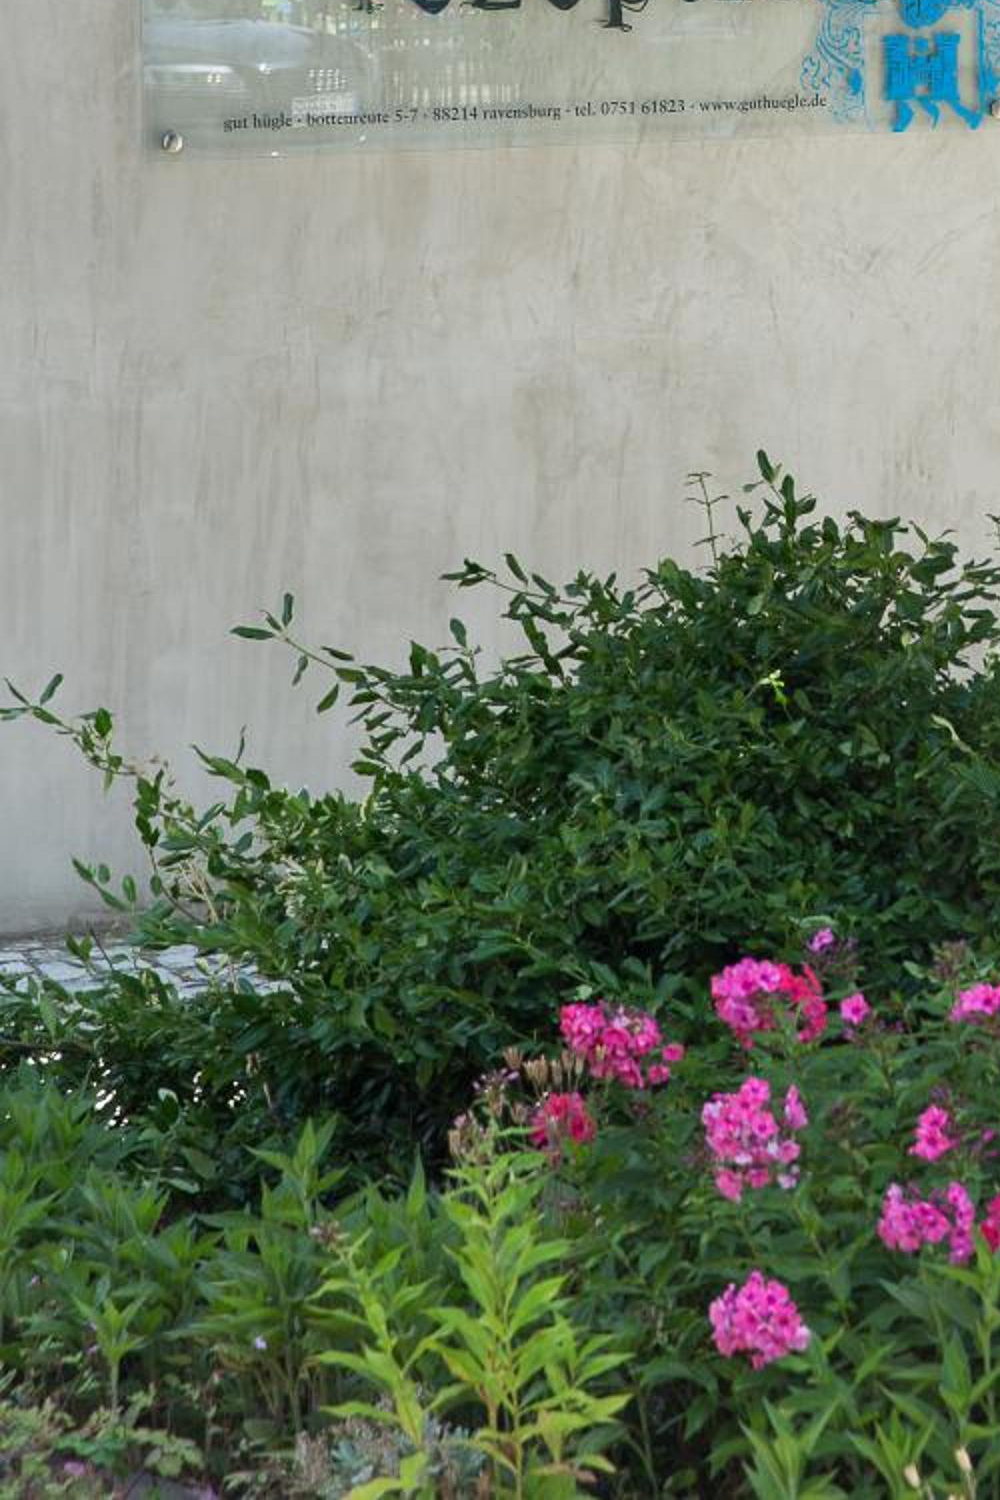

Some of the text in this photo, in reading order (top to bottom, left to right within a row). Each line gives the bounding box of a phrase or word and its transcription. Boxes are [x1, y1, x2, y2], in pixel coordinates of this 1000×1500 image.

[223, 93, 828, 132] gut hügle bottenreute 5-7 88214 ravensburg tel. 0751 61823 www.guthuegle.de
